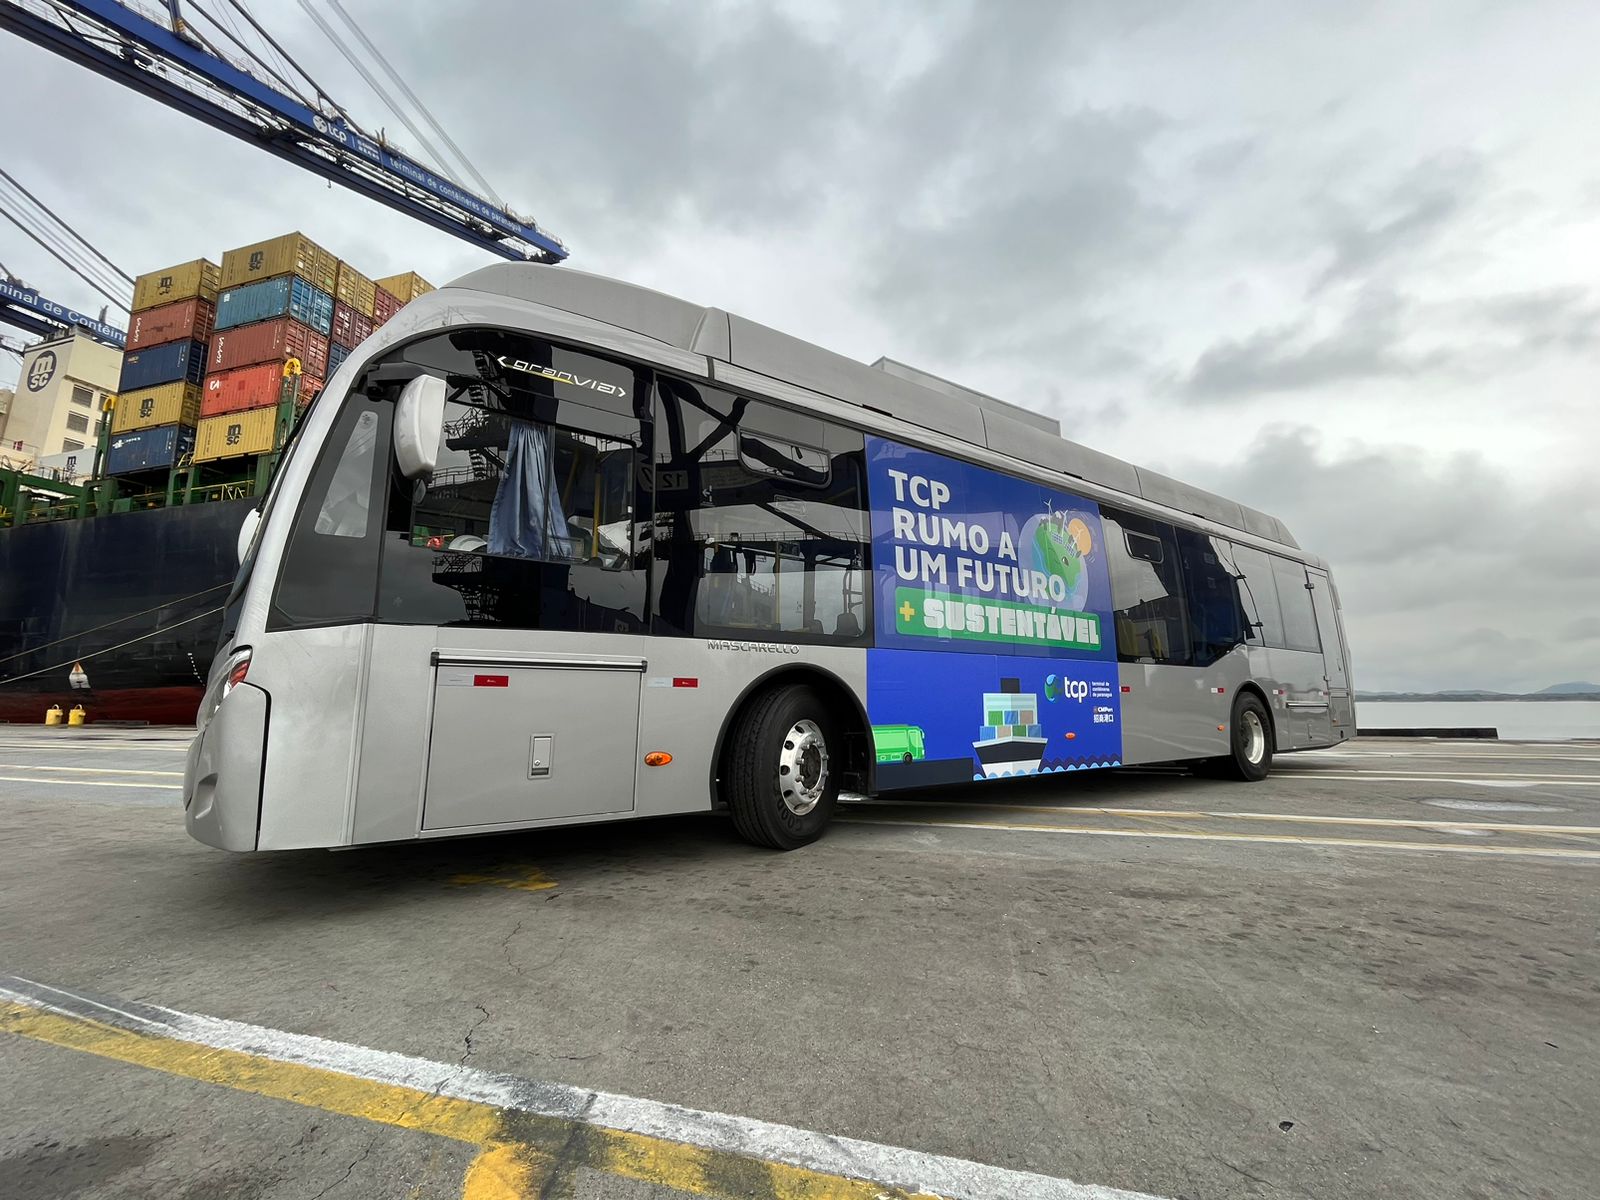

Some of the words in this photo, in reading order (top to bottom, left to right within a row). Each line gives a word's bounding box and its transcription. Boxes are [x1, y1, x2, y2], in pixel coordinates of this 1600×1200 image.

[390, 157, 425, 182] terminal
[427, 178, 437, 189] de
[43, 300, 62, 315] de
[888, 469, 950, 510] TCP
[892, 507, 989, 555] RUMO
[997, 531, 1017, 561] A
[895, 546, 947, 585] UM
[957, 556, 1066, 602] FUTURO
[923, 598, 1100, 645] SUSTENTÁVEL
[707, 640, 800, 655] MASCARELLO
[1064, 676, 1088, 703] tcp
